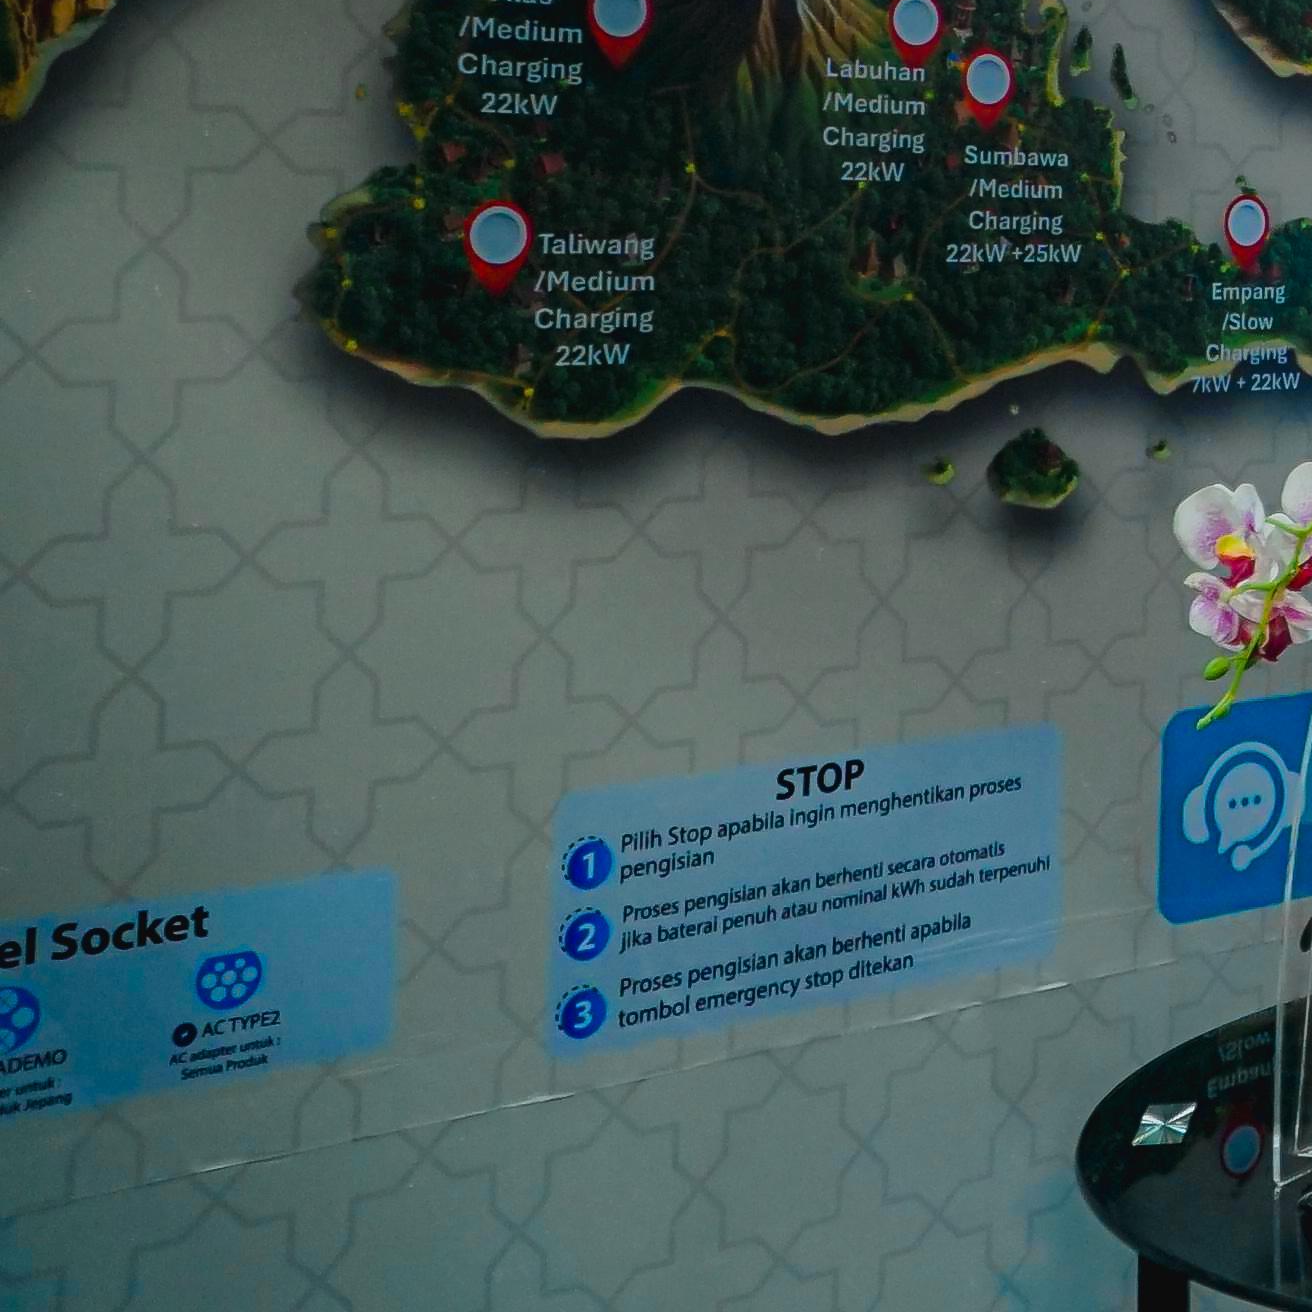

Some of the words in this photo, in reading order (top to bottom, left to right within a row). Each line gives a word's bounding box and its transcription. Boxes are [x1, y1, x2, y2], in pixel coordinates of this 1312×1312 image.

[459, 15, 582, 44] /Medium
[457, 52, 582, 85] Charging
[826, 58, 925, 82] Labuhan
[480, 92, 558, 115] 22kW
[822, 92, 926, 116] /Medium
[822, 126, 925, 154] Charging
[964, 145, 1069, 168] Sumbawa
[841, 162, 904, 182] 22kW
[969, 179, 1063, 199] /Medium
[969, 210, 1063, 235] Charging
[538, 233, 655, 262] Taliwang
[946, 244, 1007, 263] 22kW
[534, 270, 655, 293] /Medium
[1212, 282, 1286, 304] Empang
[534, 306, 654, 334] Charging
[1222, 312, 1273, 331] /Slow
[555, 343, 630, 367] 22kW
[1206, 343, 1288, 365] Charging
[1251, 372, 1300, 392] 22kW
[775, 759, 865, 801] STOP
[622, 830, 662, 853] Pilih
[668, 824, 713, 847] Stop
[717, 810, 784, 841] apabila
[789, 805, 835, 829] ingin
[840, 783, 965, 817] menghentikan
[969, 776, 1022, 802] proses
[620, 849, 715, 884] pengisian
[623, 899, 680, 922] Proses
[684, 884, 766, 915] pengisian
[771, 876, 811, 896] akan
[816, 862, 884, 889] berhenti
[887, 856, 936, 877] secara
[939, 841, 1006, 866] otomatis
[619, 931, 652, 954] jika
[658, 917, 718, 944] baterai
[722, 906, 777, 933] penuh
[781, 898, 817, 920] atau
[822, 883, 887, 912] nominal
[891, 879, 925, 899] kWh
[929, 872, 975, 893] sudah
[979, 855, 1051, 885] terpenuhi
[51, 905, 209, 962] Socket
[619, 971, 683, 997] Proses
[688, 952, 779, 988] pengisian
[783, 944, 827, 965] akan
[832, 924, 906, 956] berhenti
[910, 912, 972, 940] apabila
[618, 995, 690, 1028] tombol
[695, 977, 801, 1008] emergency
[805, 969, 844, 989] stop
[849, 951, 914, 981] ditekan
